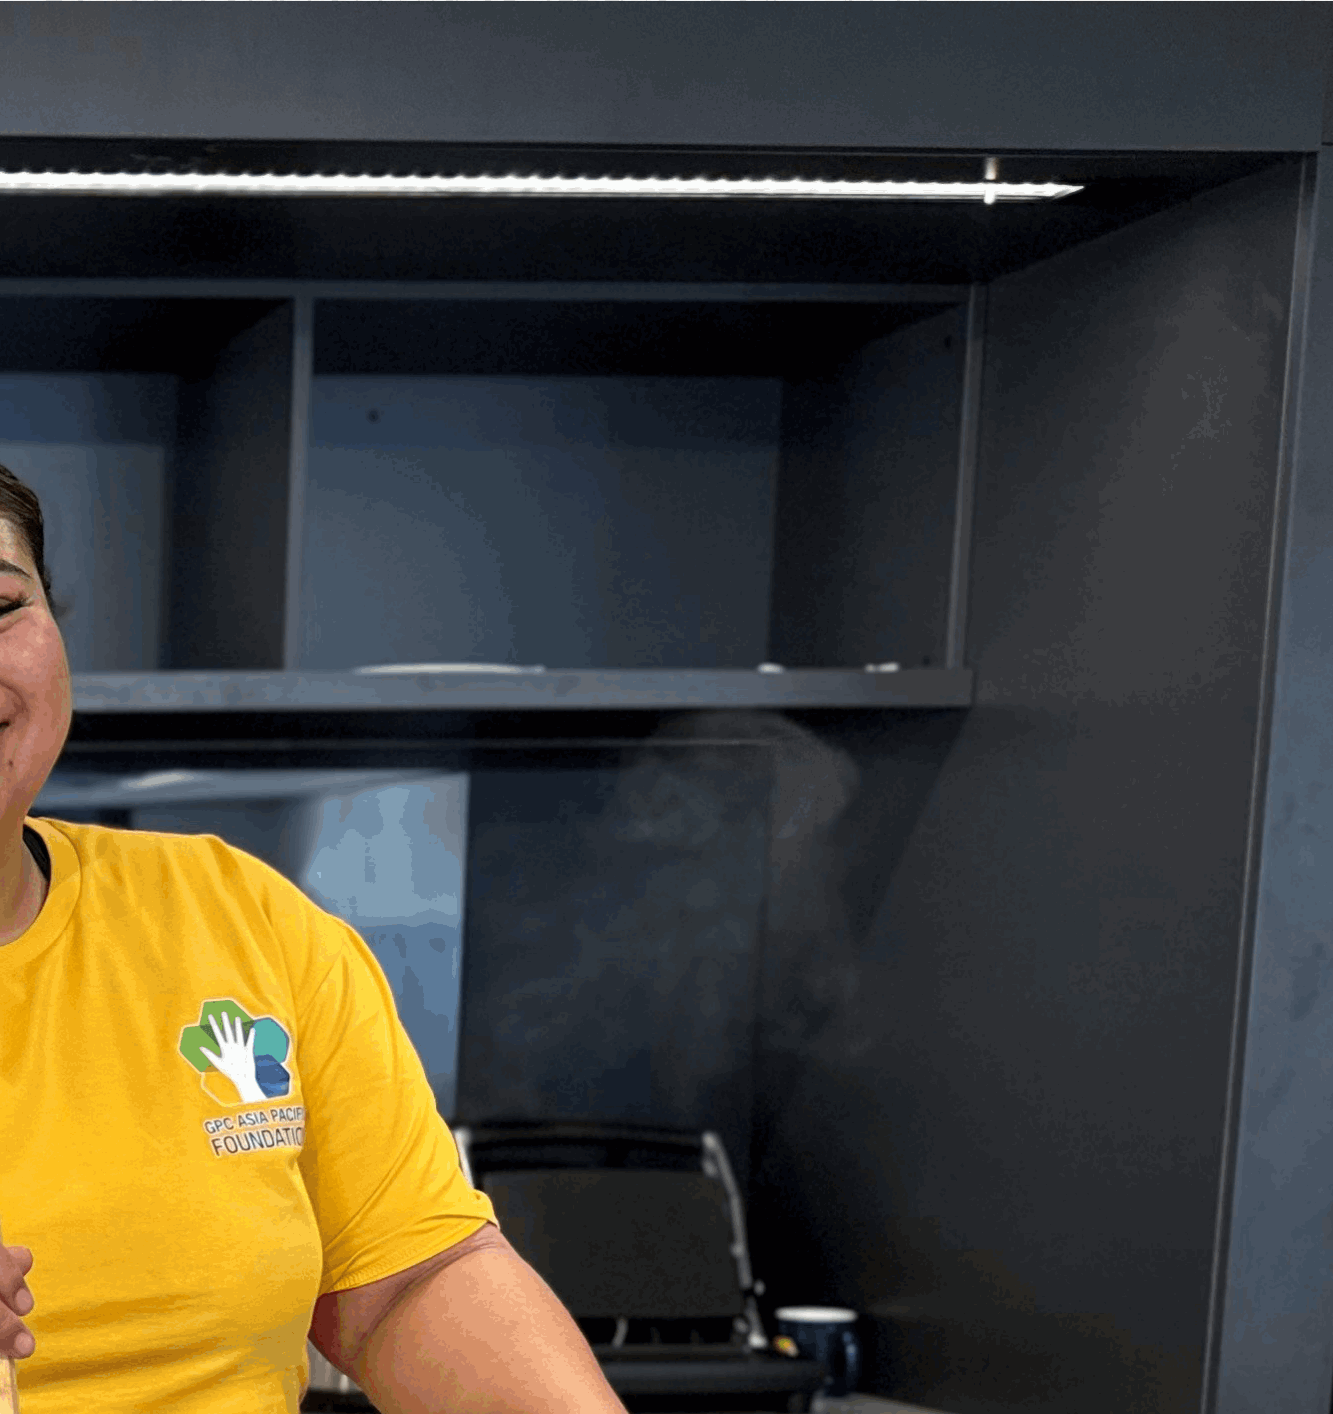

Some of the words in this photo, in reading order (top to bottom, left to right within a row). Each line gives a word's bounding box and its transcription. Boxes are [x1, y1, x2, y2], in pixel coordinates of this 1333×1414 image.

[204, 1117, 234, 1134] GPC
[238, 1111, 268, 1127] ASIA
[270, 1107, 304, 1122] PACIF
[211, 1126, 303, 1156] FOUNDATIO
